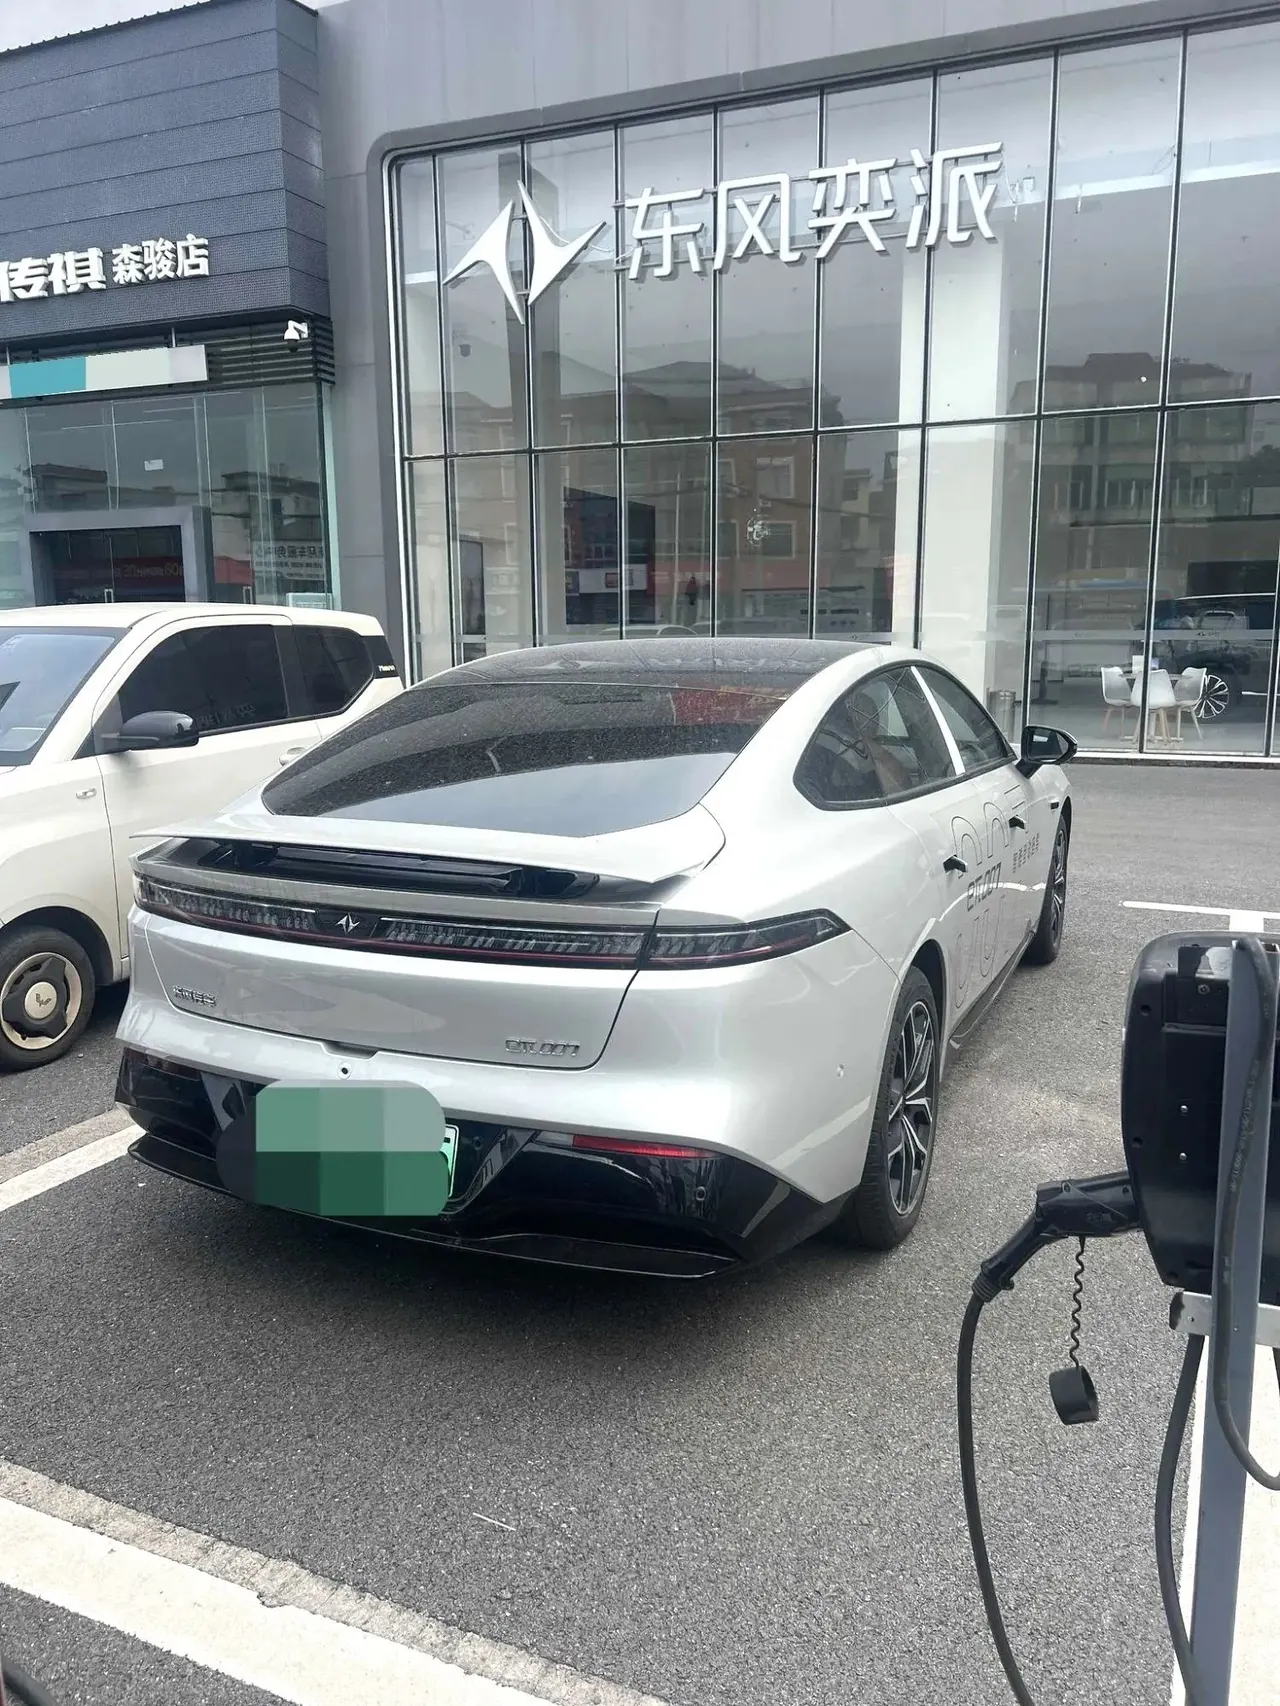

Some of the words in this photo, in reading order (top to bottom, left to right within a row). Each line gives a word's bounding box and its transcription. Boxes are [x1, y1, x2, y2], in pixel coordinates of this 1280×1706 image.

[625, 142, 1002, 280] 东风奕派
[0, 247, 106, 302] 传祺
[112, 233, 209, 284] 森骏店
